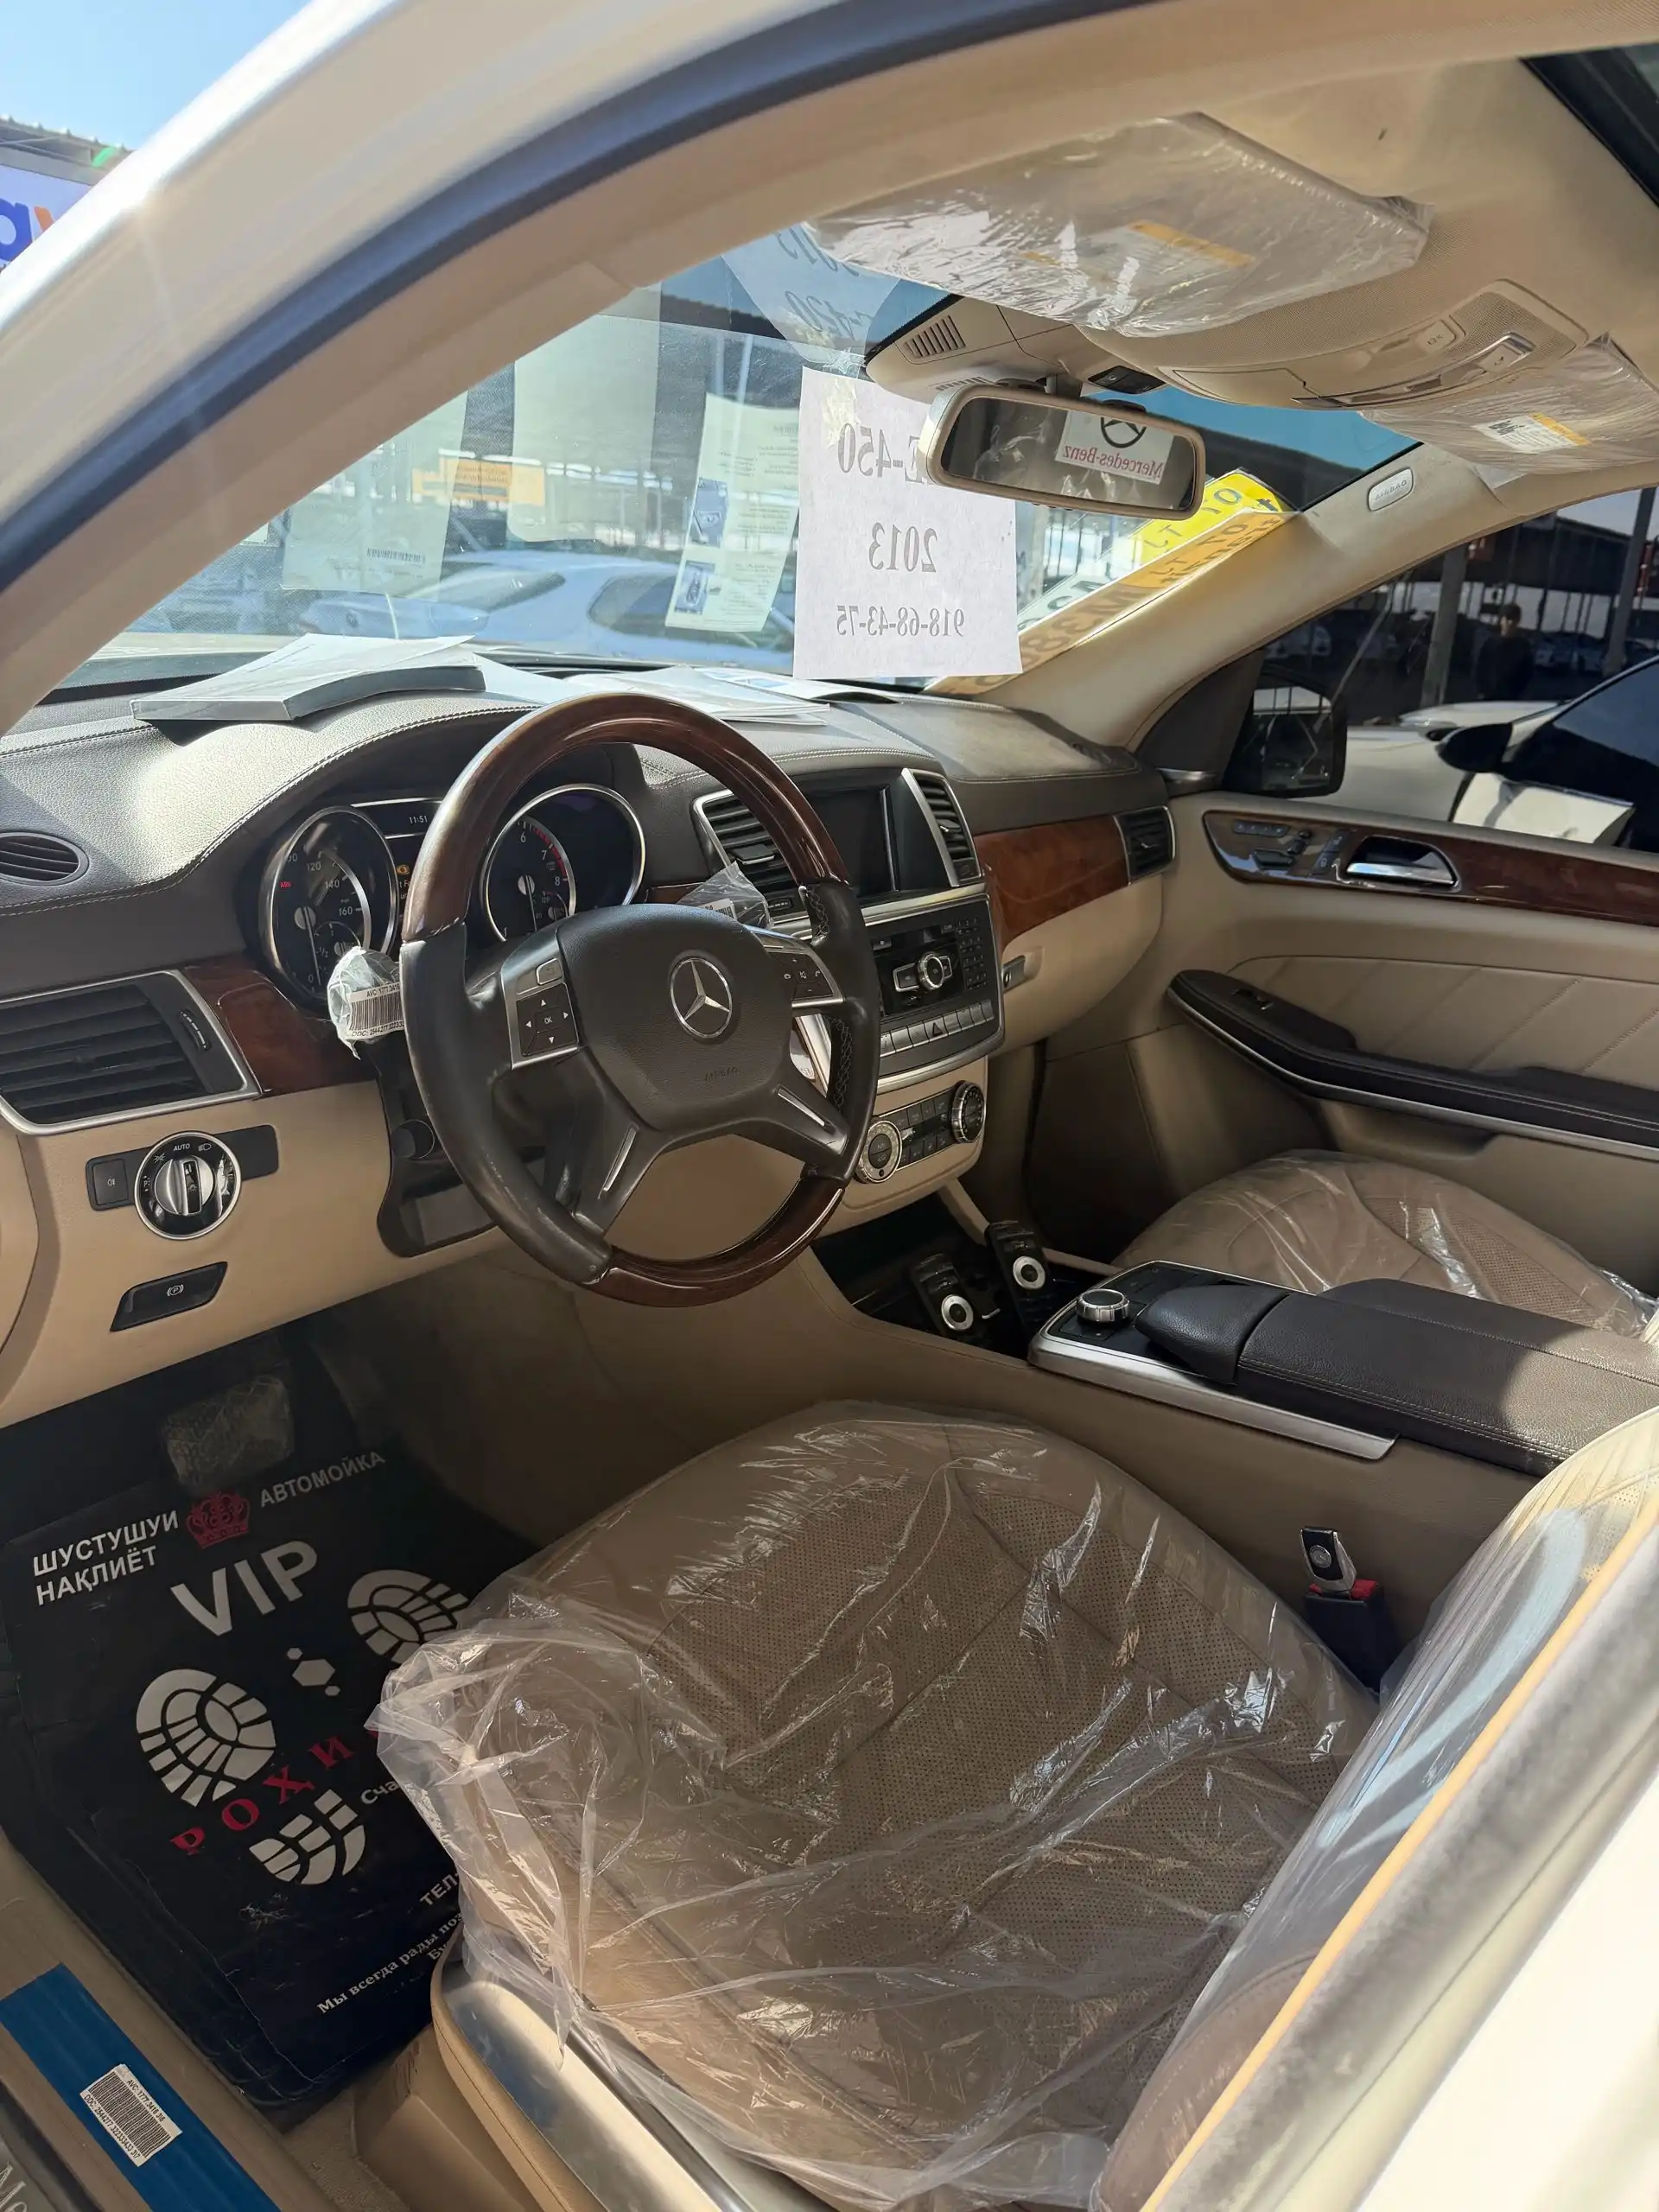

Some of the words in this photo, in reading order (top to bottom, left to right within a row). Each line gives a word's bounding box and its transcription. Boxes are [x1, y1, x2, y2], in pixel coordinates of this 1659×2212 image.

[408, 815, 429, 824] 11:51
[520, 831, 526, 843] 6
[541, 849, 547, 861] 7
[307, 861, 321, 872] 120
[325, 880, 340, 890] 140
[555, 876, 561, 887] 8
[339, 906, 353, 916] 160
[544, 1016, 553, 1025] OK
[173, 1142, 191, 1152] AUTO
[260, 1451, 386, 1508] АВТОМОЙКА
[33, 1510, 180, 1577] ШУСТУШУИ
[36, 1545, 156, 1606] НАҚЛИЁТ
[170, 1541, 318, 1637] VIP
[361, 1780, 399, 1805] Сча
[316, 1992, 349, 2015] Мы
[349, 1961, 399, 1997] всегда
[399, 1933, 439, 1965] рады
[84, 2094, 95, 2110] DDC:
